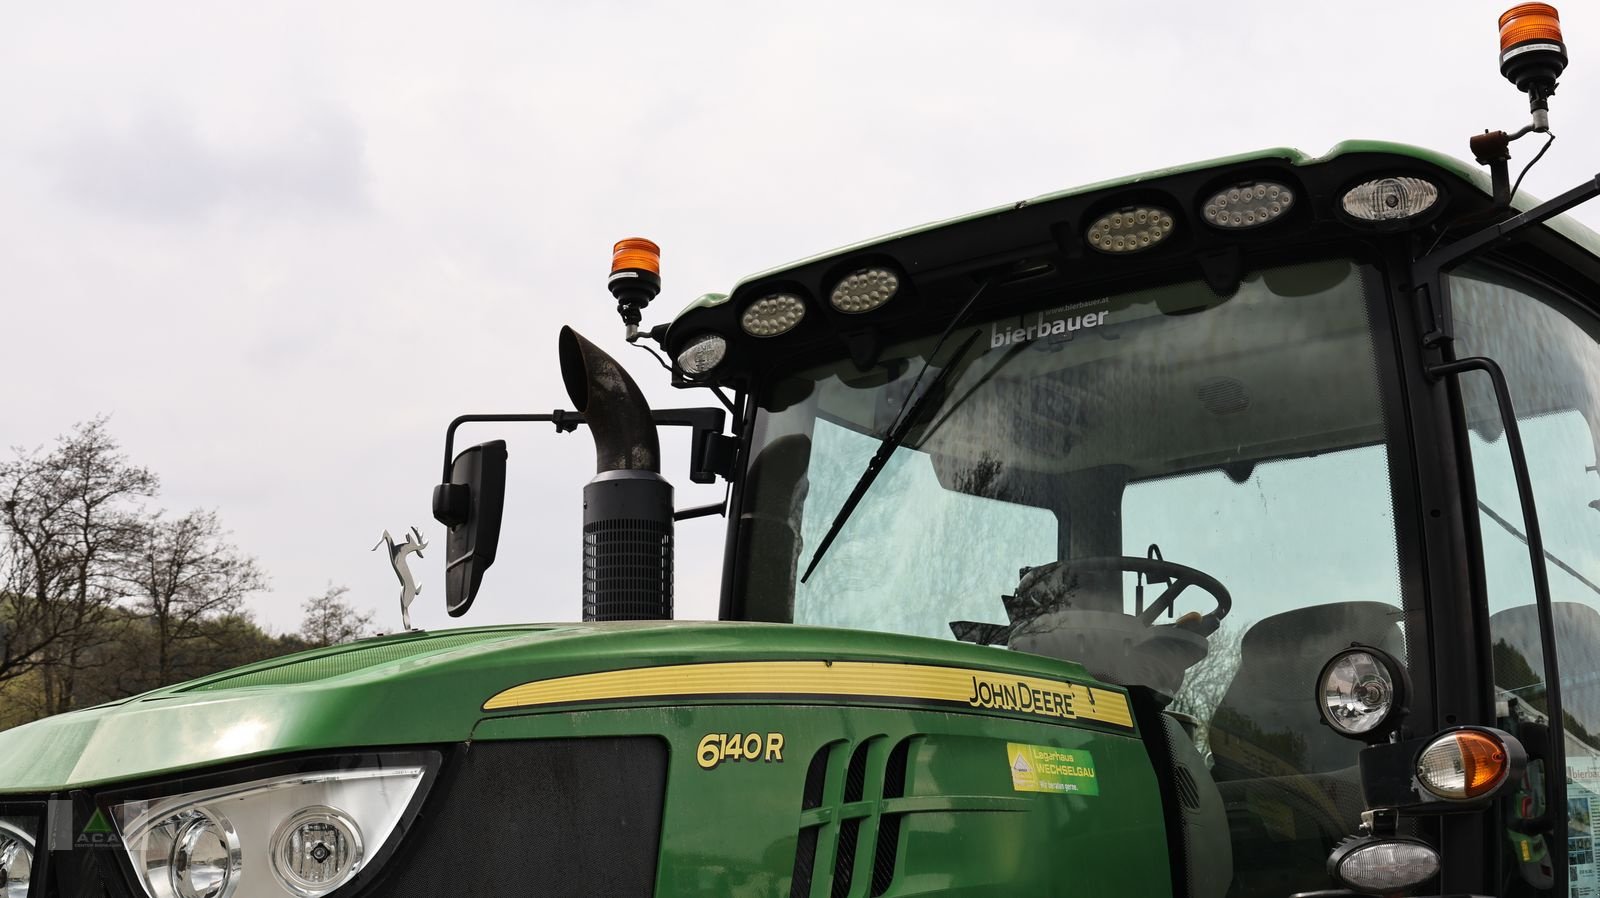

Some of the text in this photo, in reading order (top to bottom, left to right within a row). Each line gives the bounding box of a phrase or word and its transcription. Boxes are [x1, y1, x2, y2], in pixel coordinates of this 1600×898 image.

[1045, 297, 1109, 315] www.bierbauer.at
[991, 310, 1109, 349] bierbauer
[1033, 748, 1074, 763] Lagerhaus
[1036, 763, 1095, 778] WECHSELGAU
